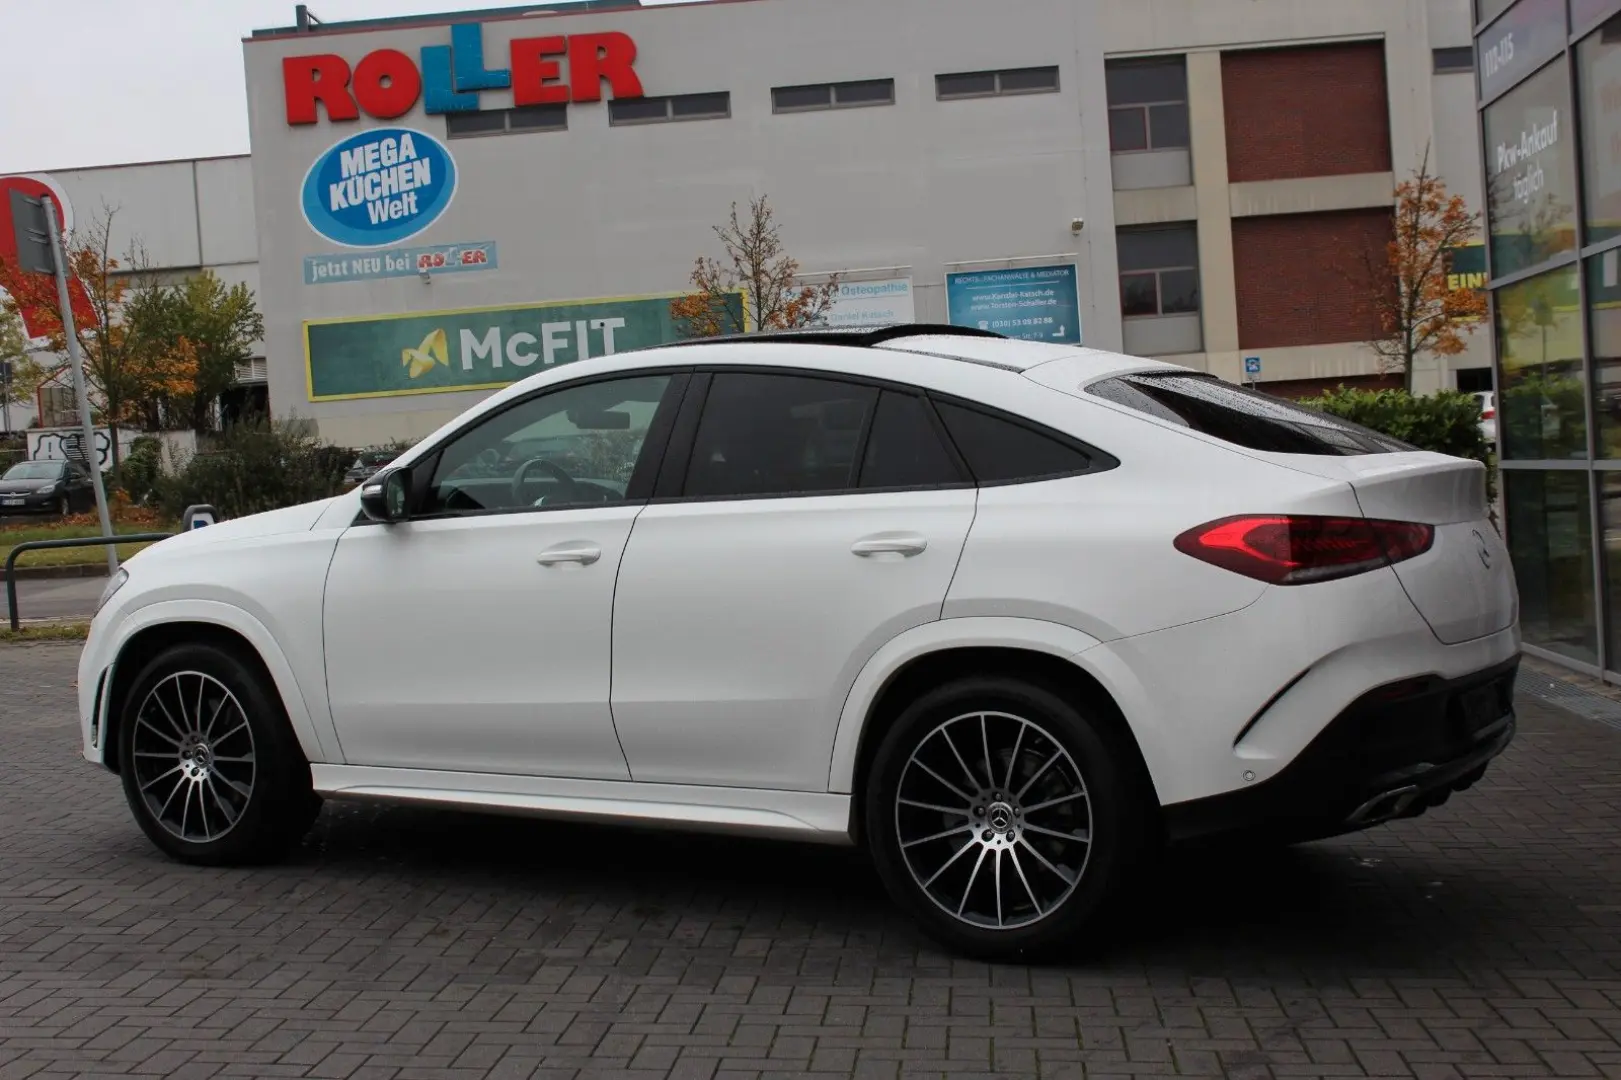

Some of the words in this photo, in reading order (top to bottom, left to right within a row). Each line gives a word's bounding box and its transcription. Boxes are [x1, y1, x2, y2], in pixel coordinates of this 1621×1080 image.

[282, 23, 645, 125] ROLLER
[340, 133, 416, 178] MEGA
[1497, 109, 1557, 173] Pkw-Ankauf
[329, 157, 431, 212] KÜCHEN
[1513, 150, 1544, 205] täglich
[367, 192, 418, 225] Welt
[312, 258, 348, 282] jetzt
[352, 258, 381, 275] NEU
[386, 253, 410, 271] bei
[416, 246, 487, 270] ROLLER
[1036, 268, 1070, 278] MEDIATOR
[841, 283, 908, 296] Osteopathie
[459, 317, 626, 371] McFIT
[992, 320, 1011, 329] (030)
[1012, 319, 1021, 327] 53
